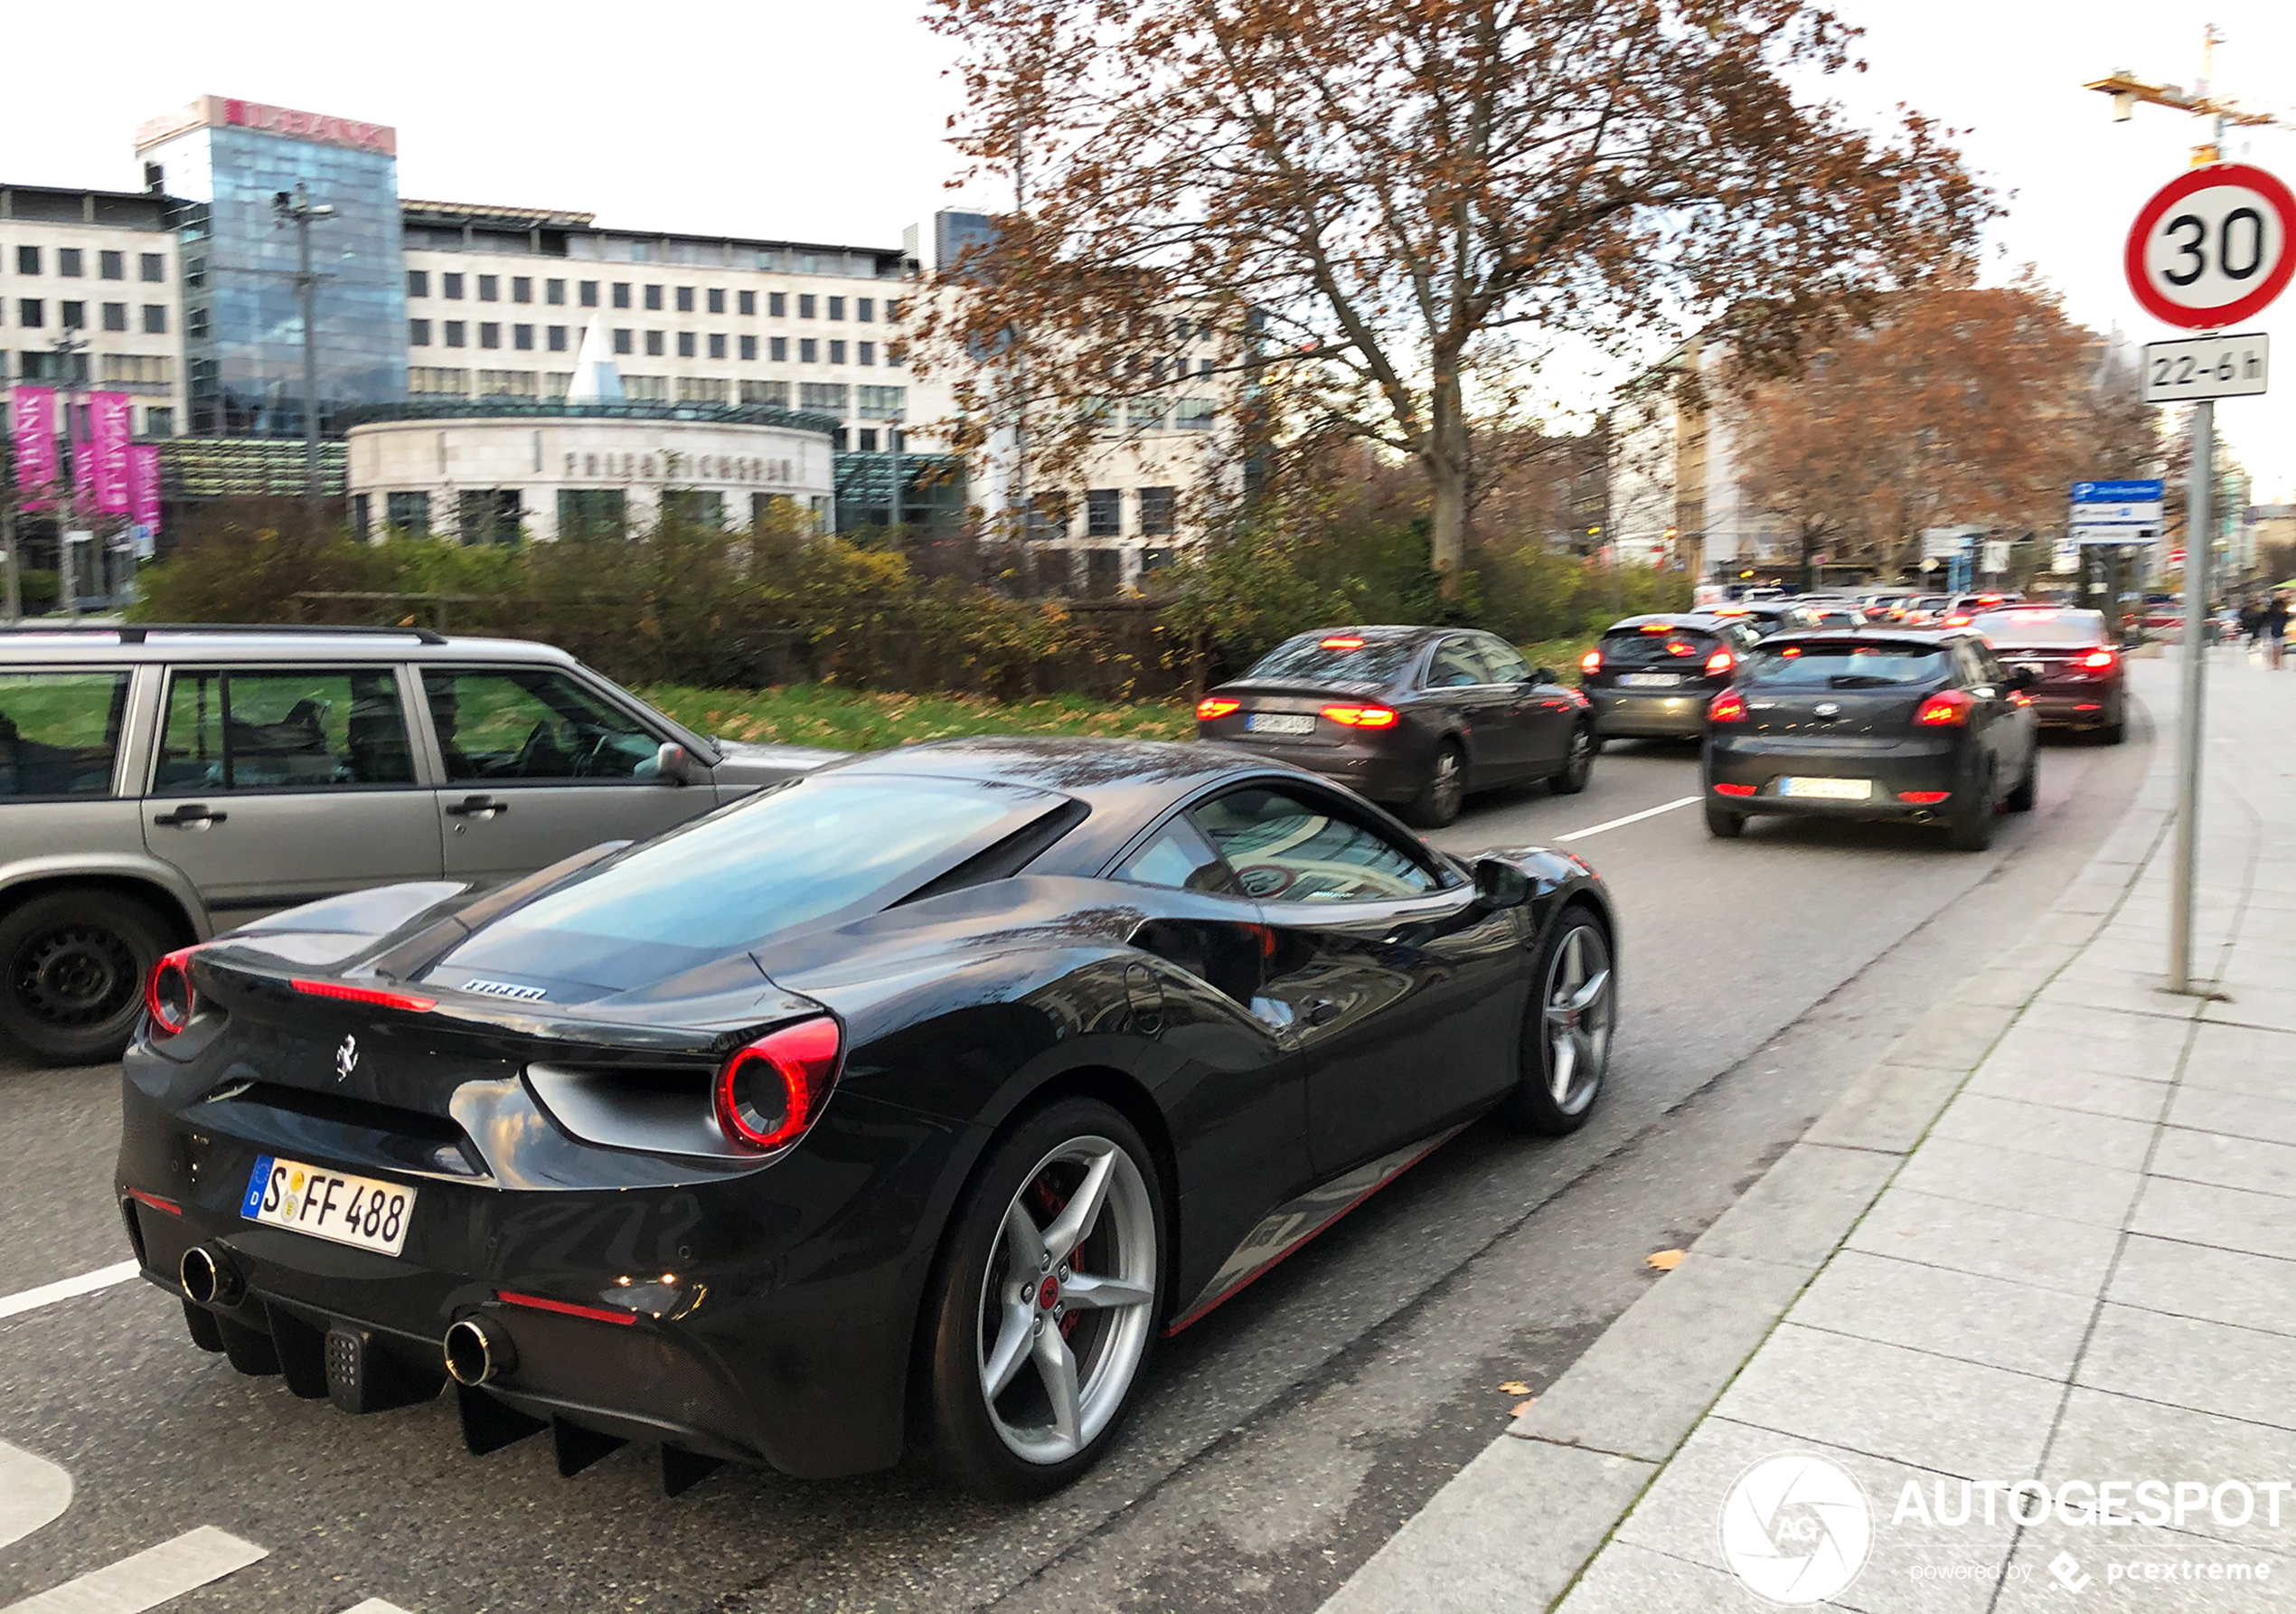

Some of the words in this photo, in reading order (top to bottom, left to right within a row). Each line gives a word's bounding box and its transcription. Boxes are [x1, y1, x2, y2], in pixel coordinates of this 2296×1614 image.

[2161, 207, 2263, 286] 30
[2152, 352, 2235, 387] 22-6
[249, 1191, 259, 1206] D
[263, 1166, 287, 1213] S
[299, 1175, 344, 1226] FF
[344, 1185, 405, 1242] 488
